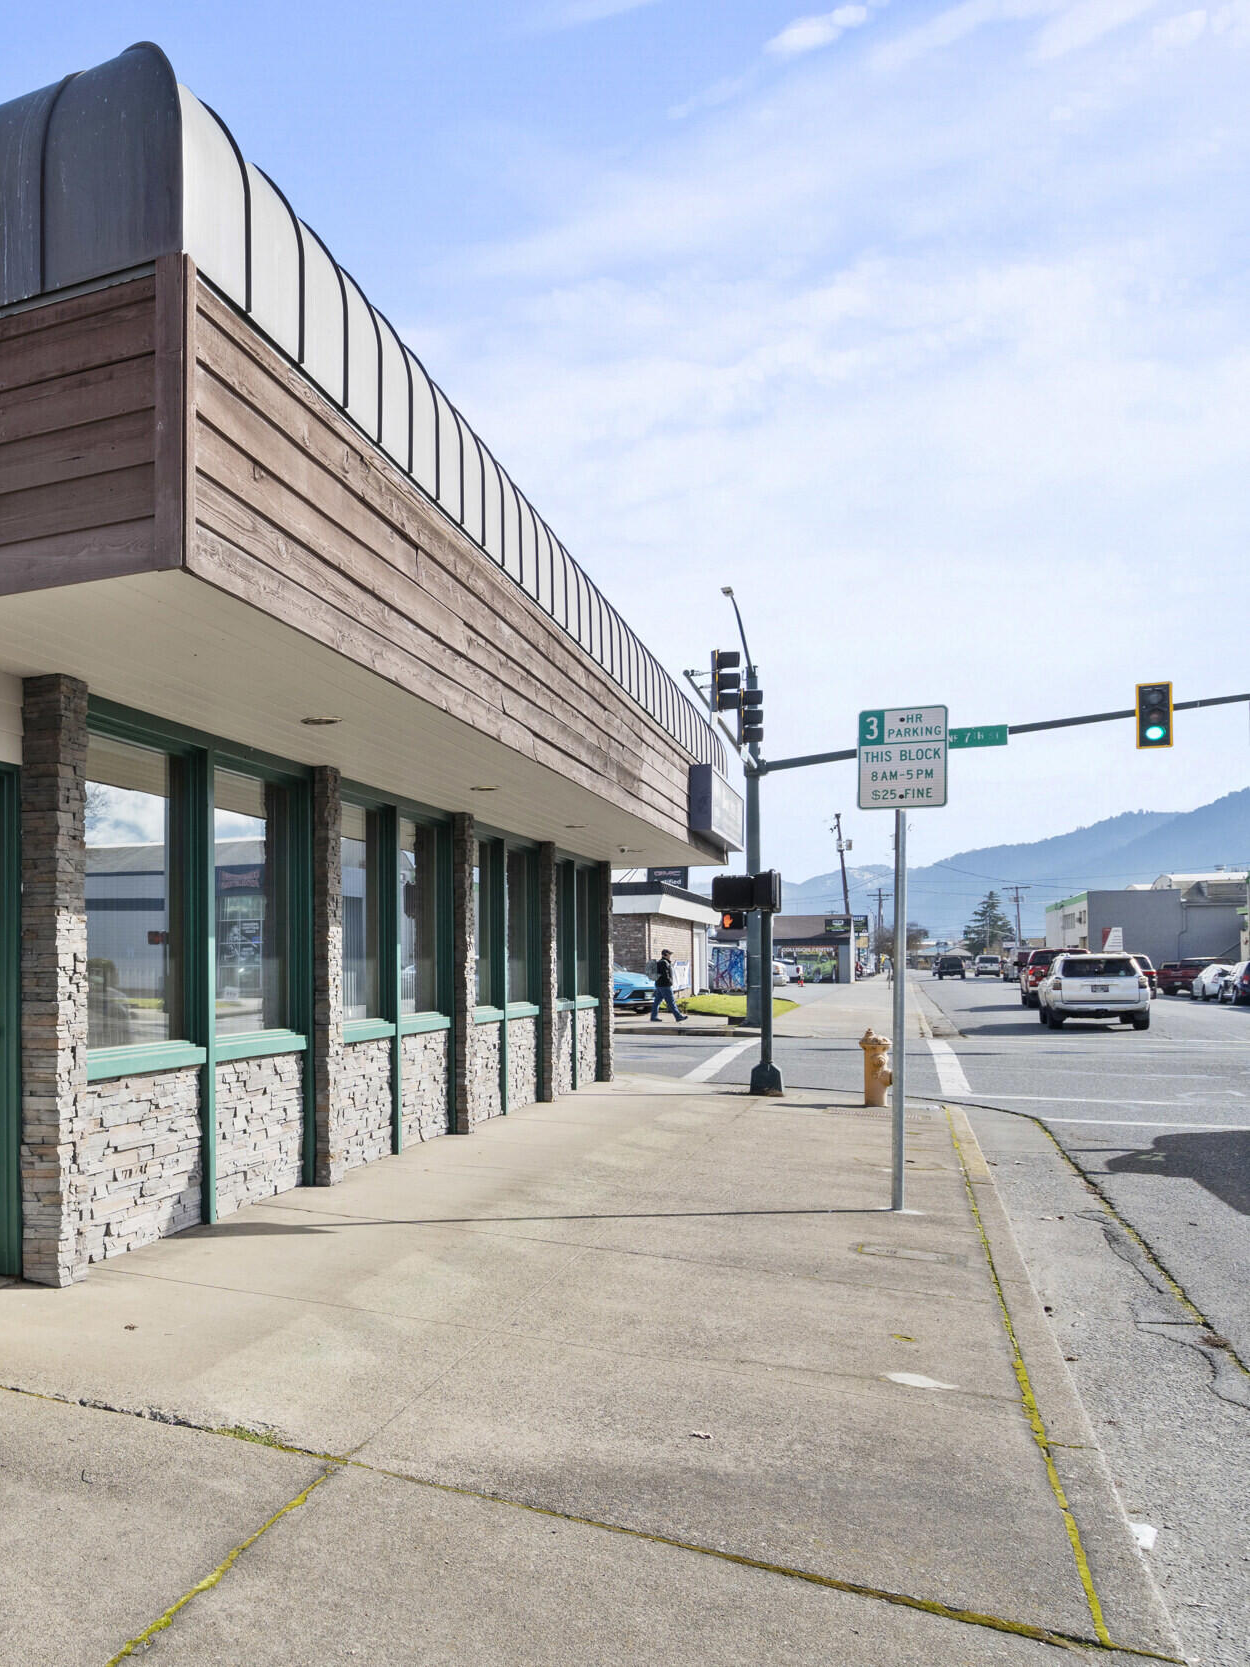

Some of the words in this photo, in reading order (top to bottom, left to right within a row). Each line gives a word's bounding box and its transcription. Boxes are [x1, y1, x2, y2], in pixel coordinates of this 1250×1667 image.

[906, 713, 923, 724] HR
[865, 716, 879, 740] 3
[887, 725, 942, 739] PARKING
[864, 750, 892, 763] THIS
[899, 748, 942, 762] BLOCK
[871, 789, 897, 801] $25
[904, 787, 933, 799] FINE
